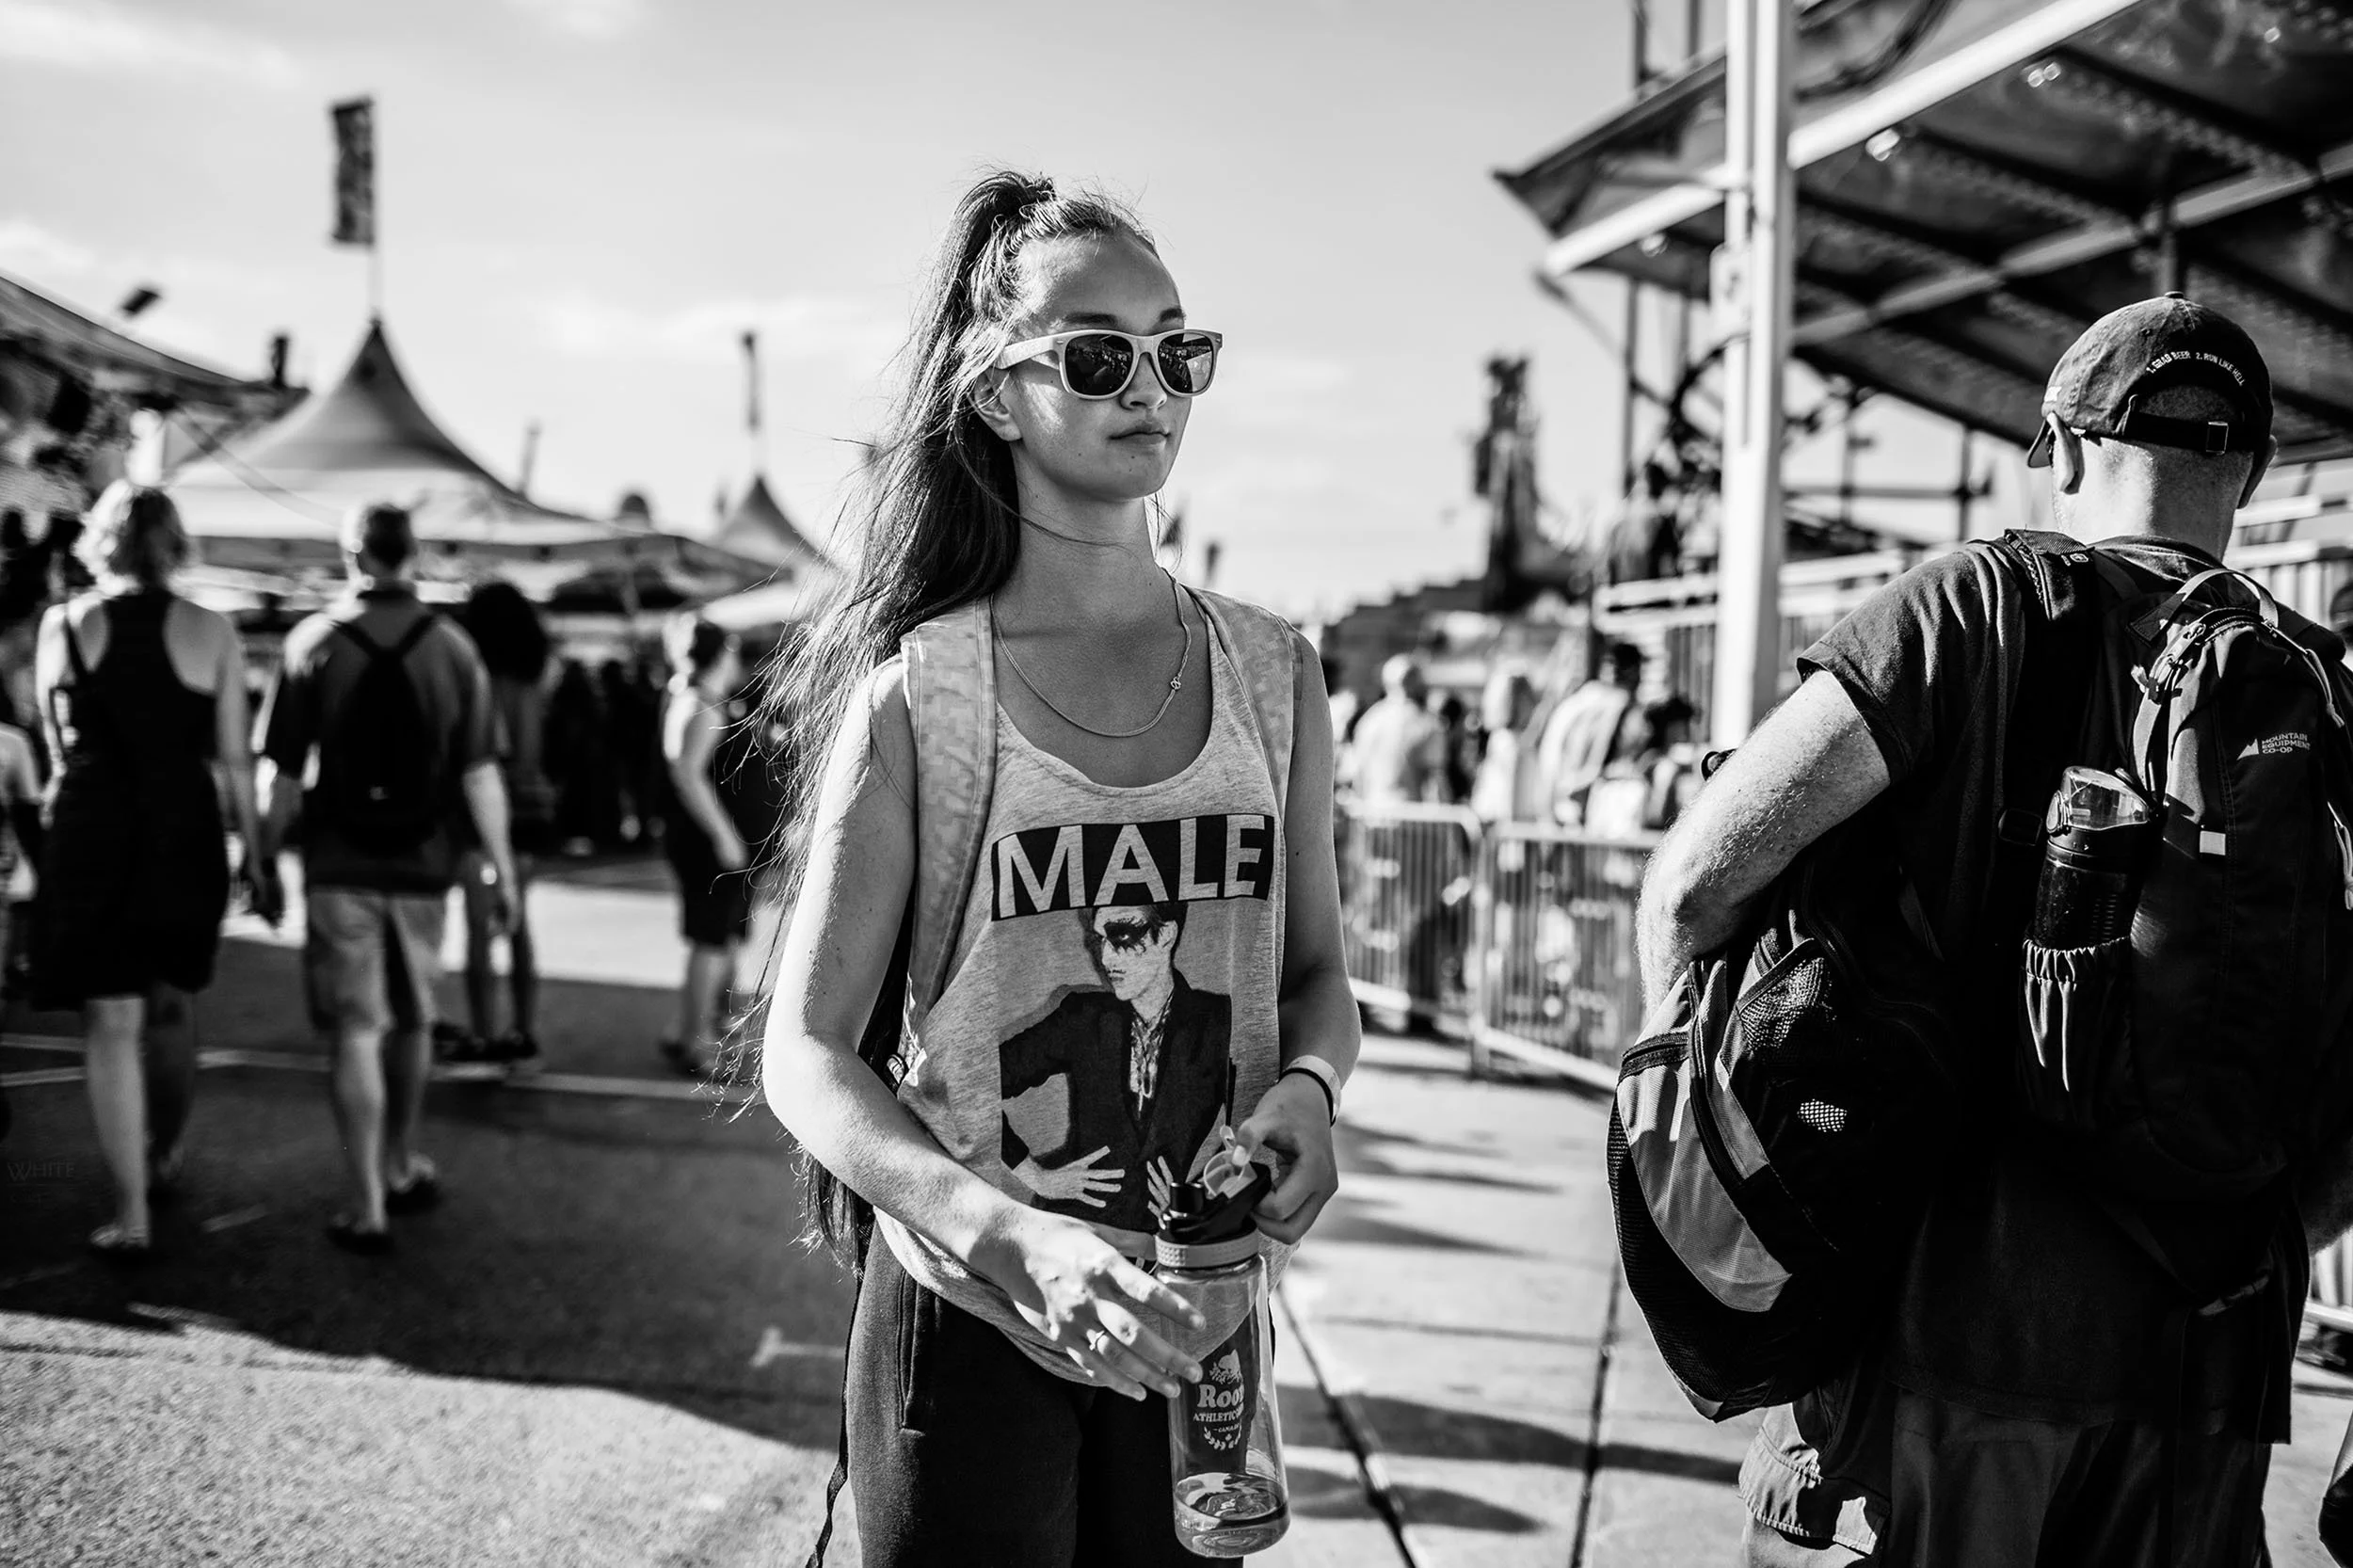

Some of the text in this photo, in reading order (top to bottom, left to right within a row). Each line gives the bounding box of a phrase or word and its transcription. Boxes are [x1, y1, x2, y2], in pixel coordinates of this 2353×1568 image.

[2152, 353, 2172, 369] GRAB
[2170, 350, 2191, 360] BEER
[2196, 352, 2203, 360] 2.
[2203, 353, 2218, 364] RUN
[2218, 358, 2234, 371] LIKE
[2232, 368, 2246, 386] HELL
[2261, 732, 2308, 744] MOUNTAIN
[998, 814, 1265, 919] MALE
